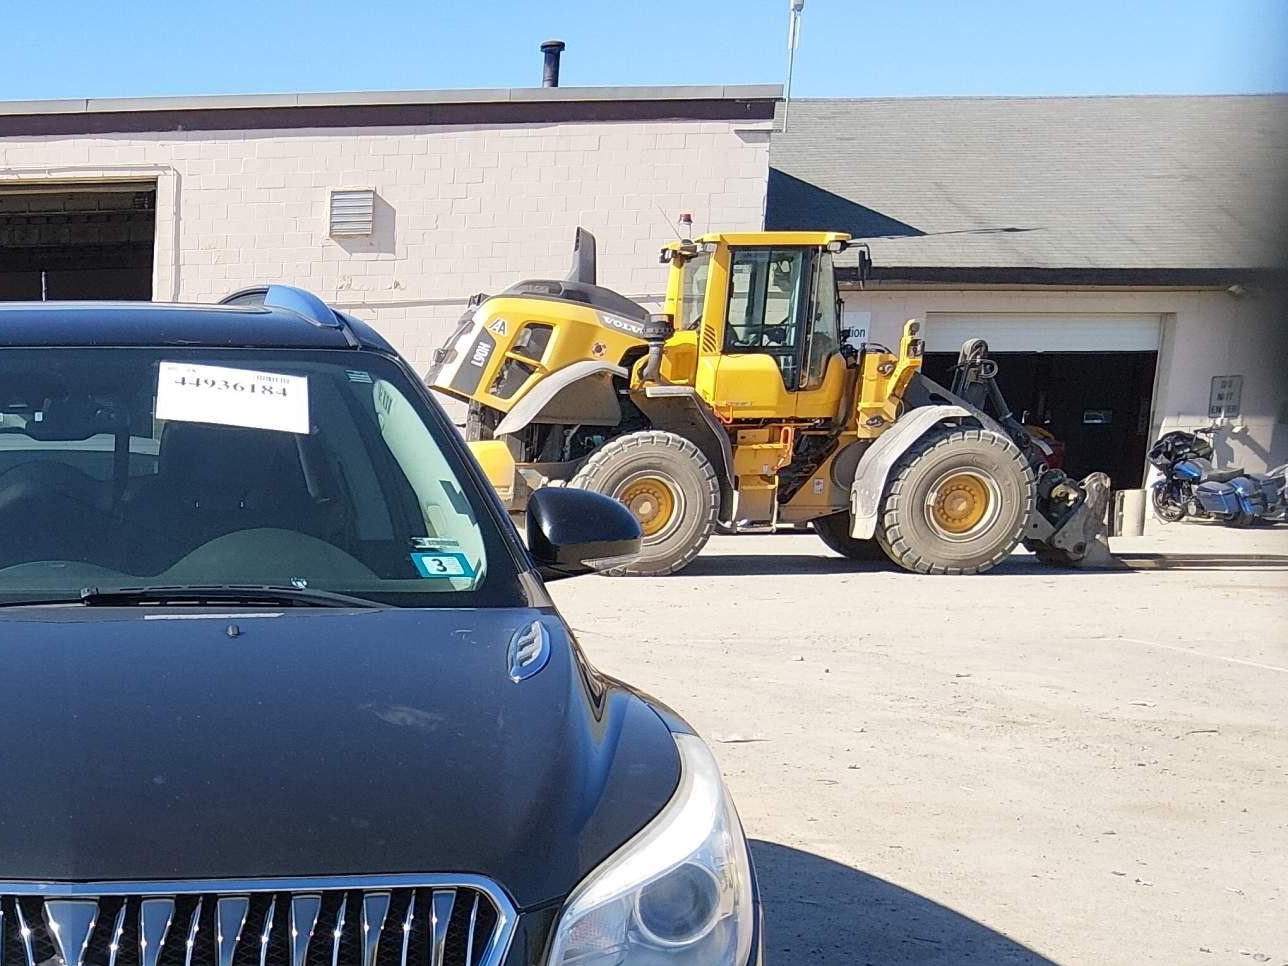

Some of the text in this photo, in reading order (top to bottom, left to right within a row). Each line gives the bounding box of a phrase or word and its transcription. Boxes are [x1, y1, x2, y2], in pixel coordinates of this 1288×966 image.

[470, 341, 492, 368] L90H
[173, 376, 288, 397] 44936184
[431, 558, 448, 573] 3
